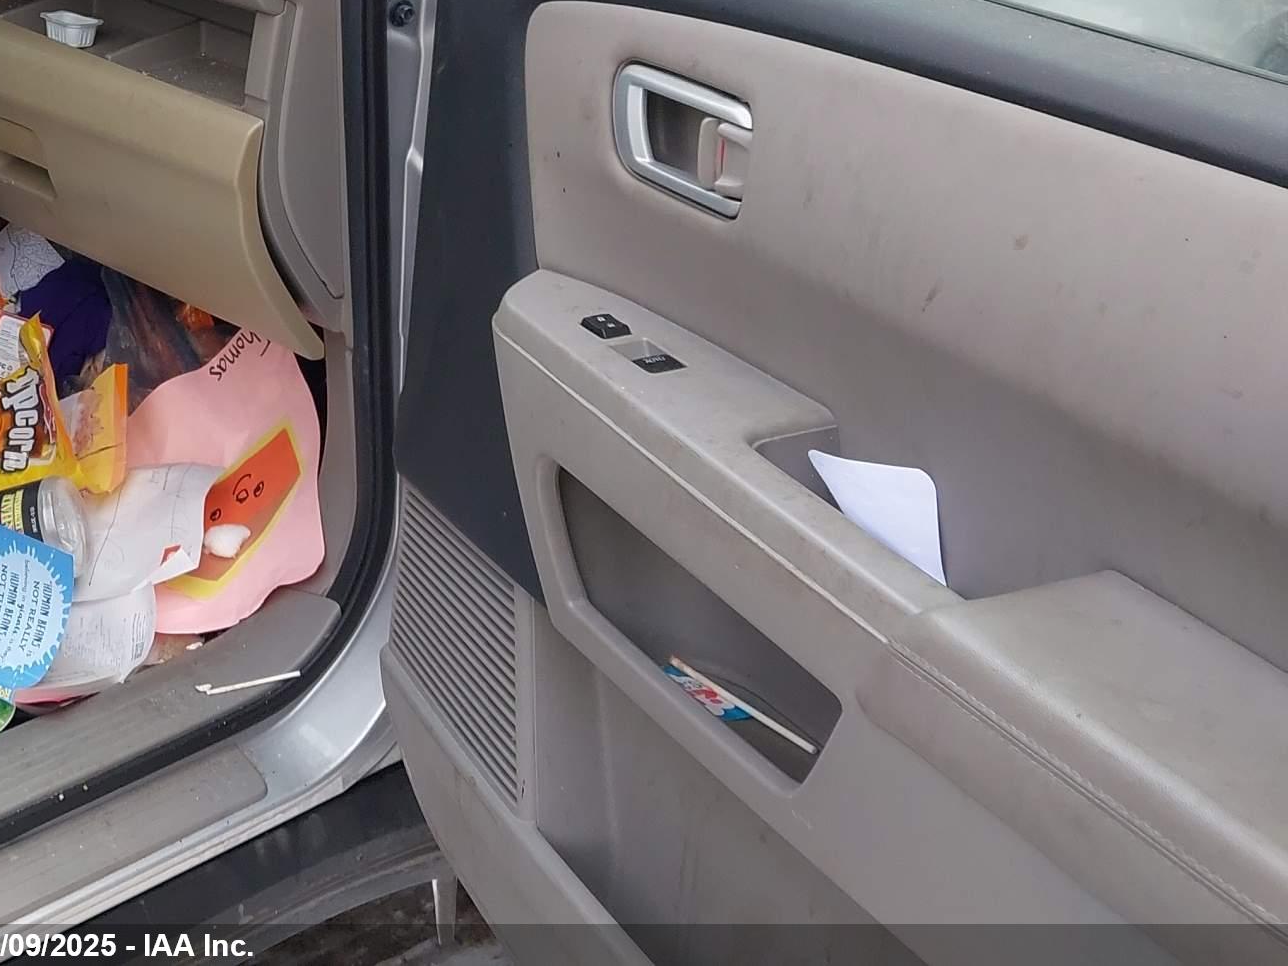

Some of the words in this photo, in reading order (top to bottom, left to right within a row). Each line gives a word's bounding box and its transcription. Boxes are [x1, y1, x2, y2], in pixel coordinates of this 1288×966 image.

[0, 564, 8, 590] NOT
[7, 571, 19, 605] HUMAN
[32, 580, 40, 606] NOT
[19, 608, 36, 651] REALLY
[32, 619, 47, 648] BEANS
